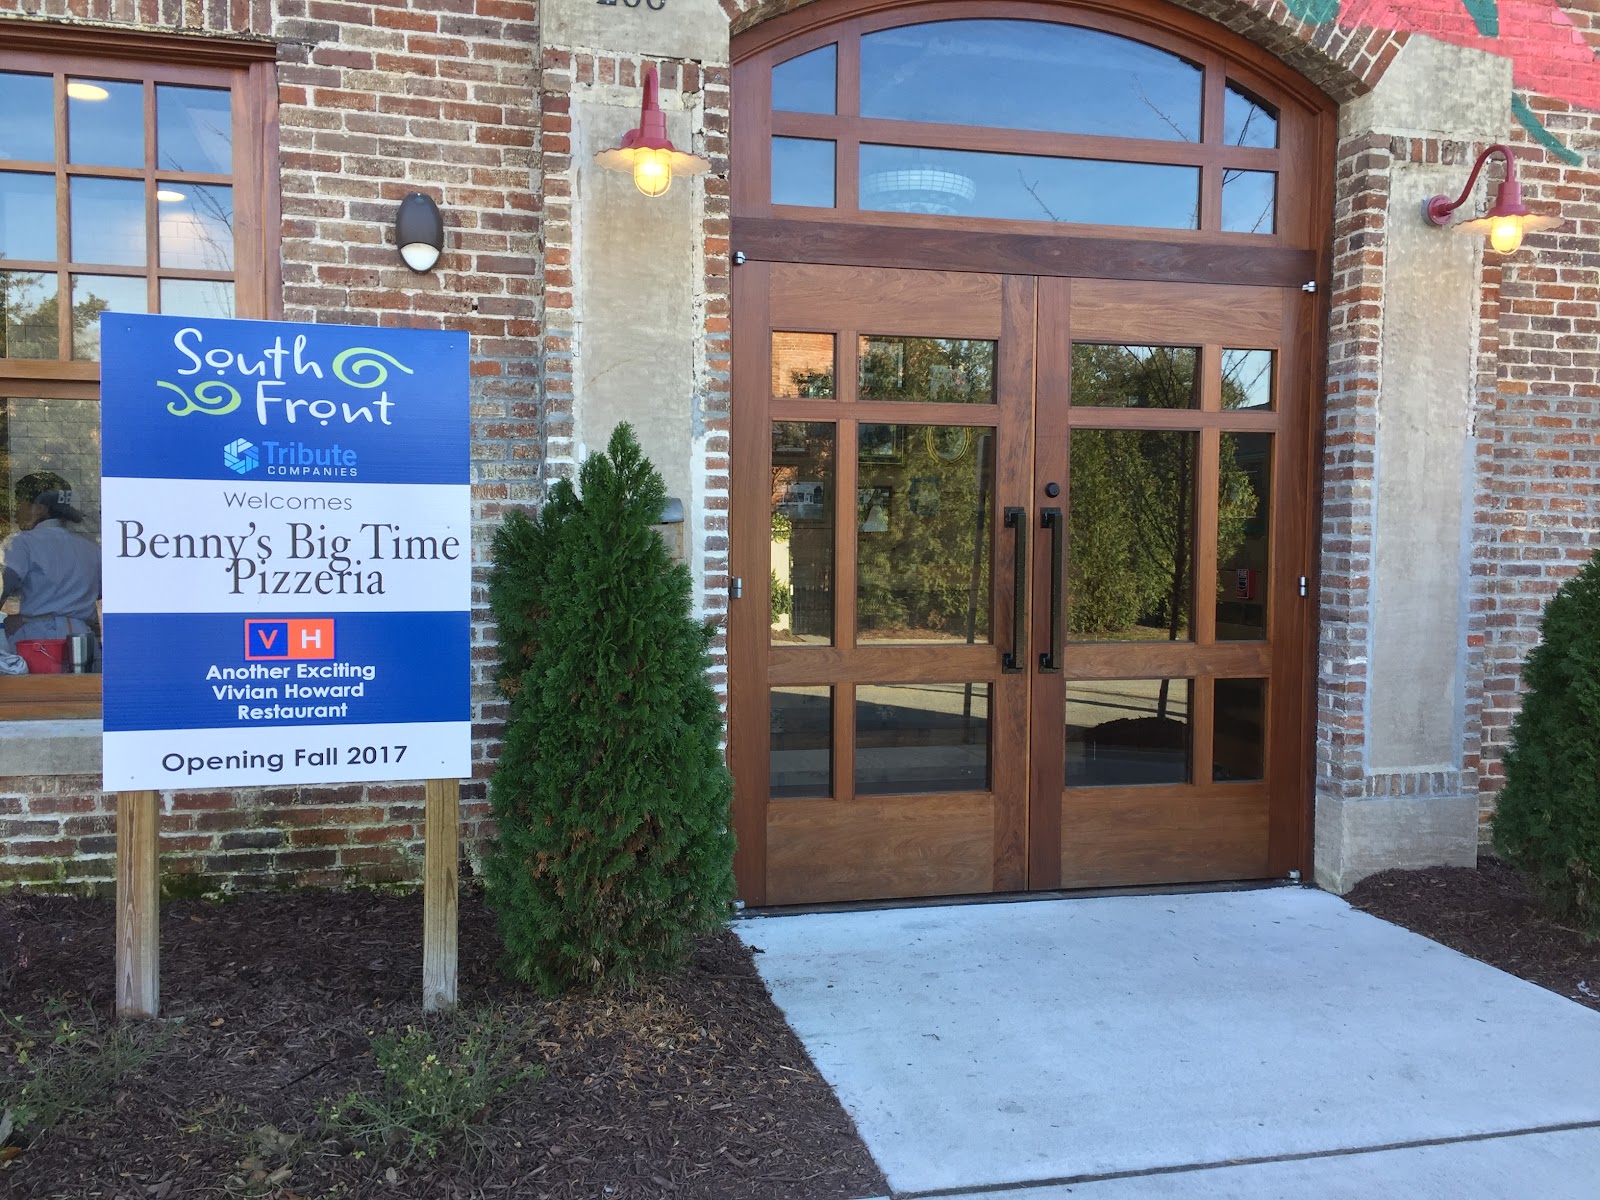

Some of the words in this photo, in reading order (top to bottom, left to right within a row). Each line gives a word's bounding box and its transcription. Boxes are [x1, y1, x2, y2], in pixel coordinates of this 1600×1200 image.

[173, 327, 324, 379] South
[255, 380, 396, 426] Front
[262, 441, 357, 467] Tribute
[267, 465, 358, 477] COMPANIES
[223, 491, 353, 511] Welcomes
[286, 521, 352, 573] Big
[360, 522, 461, 560] Time
[225, 557, 387, 595] Pizzeria
[206, 664, 291, 681] Another
[297, 662, 377, 681] Exciting
[211, 684, 279, 701] Vivian
[285, 682, 365, 699] Howard
[238, 702, 349, 721] Restaurant
[161, 750, 285, 776] Opening
[295, 748, 338, 767] Fall
[347, 745, 408, 766] 2017
